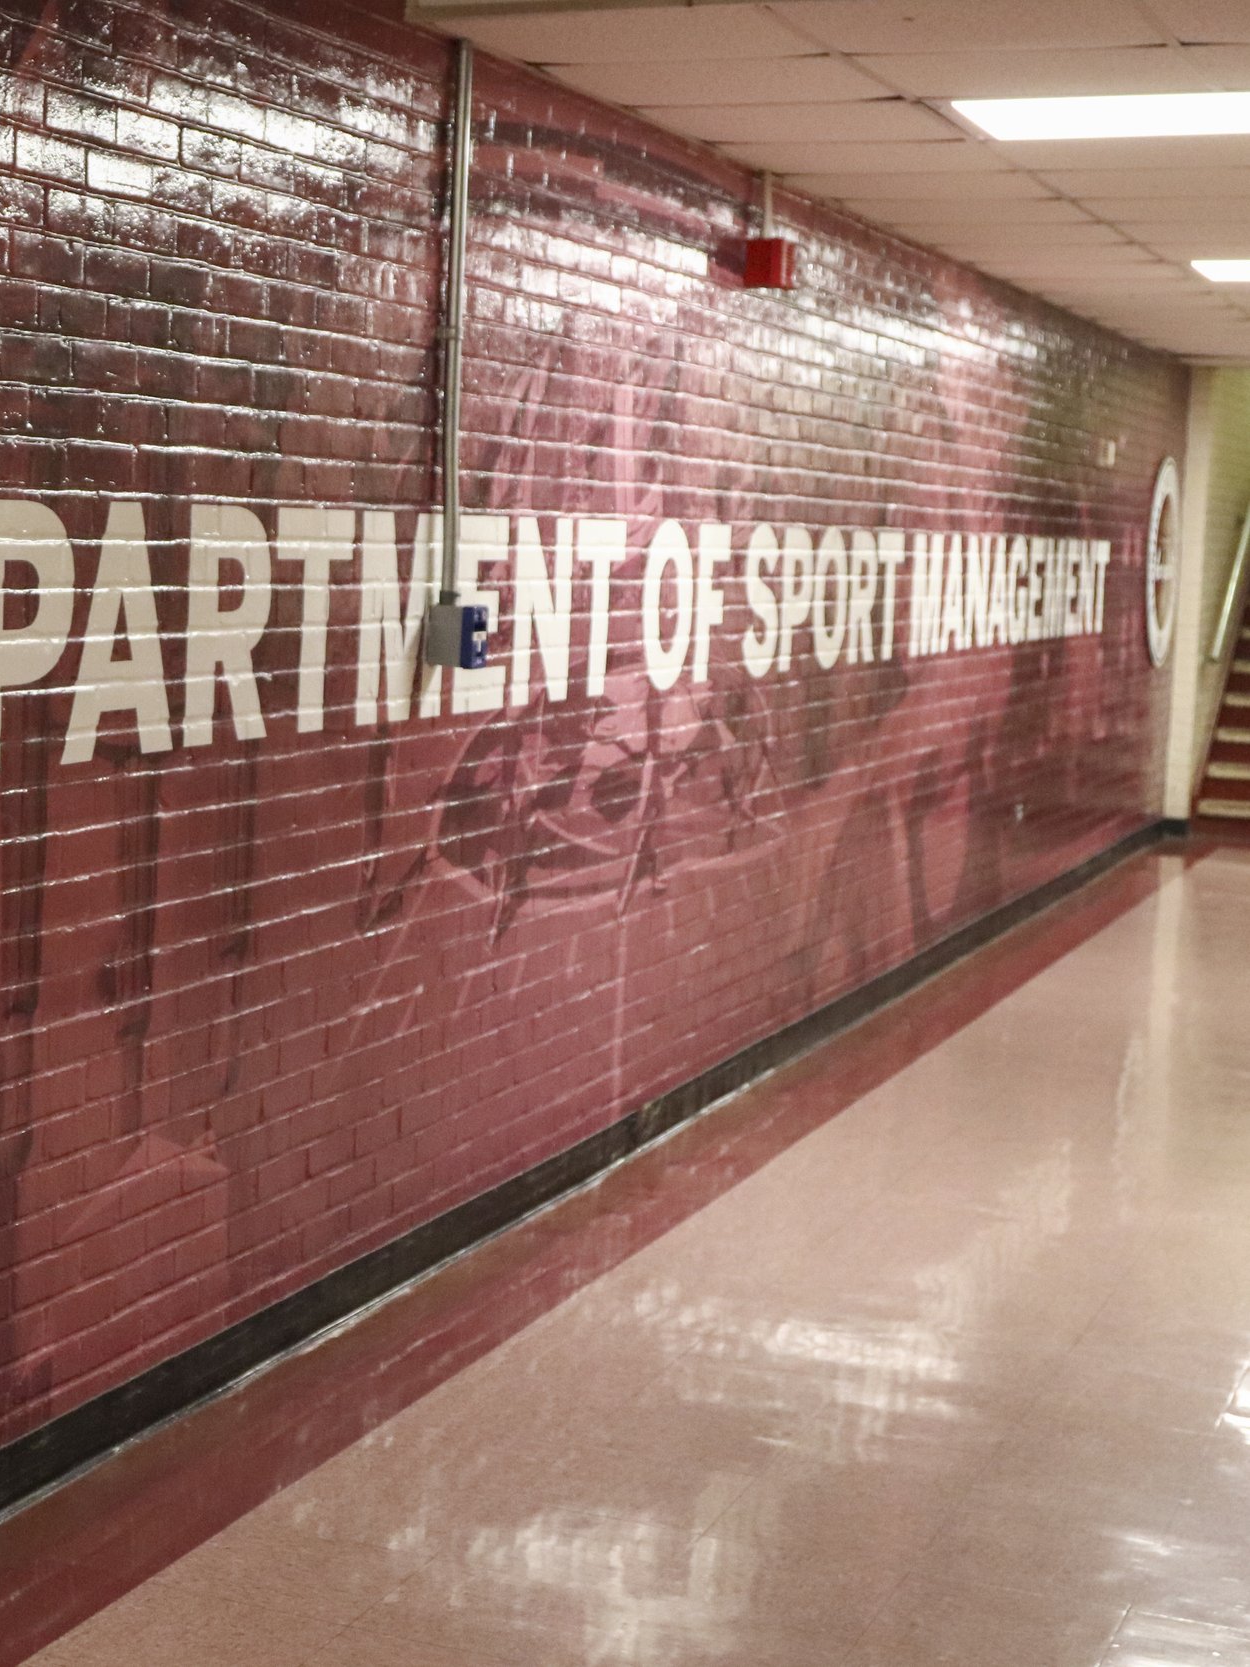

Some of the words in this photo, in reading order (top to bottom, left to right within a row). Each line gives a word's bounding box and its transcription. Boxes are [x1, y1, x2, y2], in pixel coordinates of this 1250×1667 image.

[642, 518, 732, 691] OF
[742, 522, 905, 679] SPORT
[908, 532, 1112, 658] MANAGEMENT
